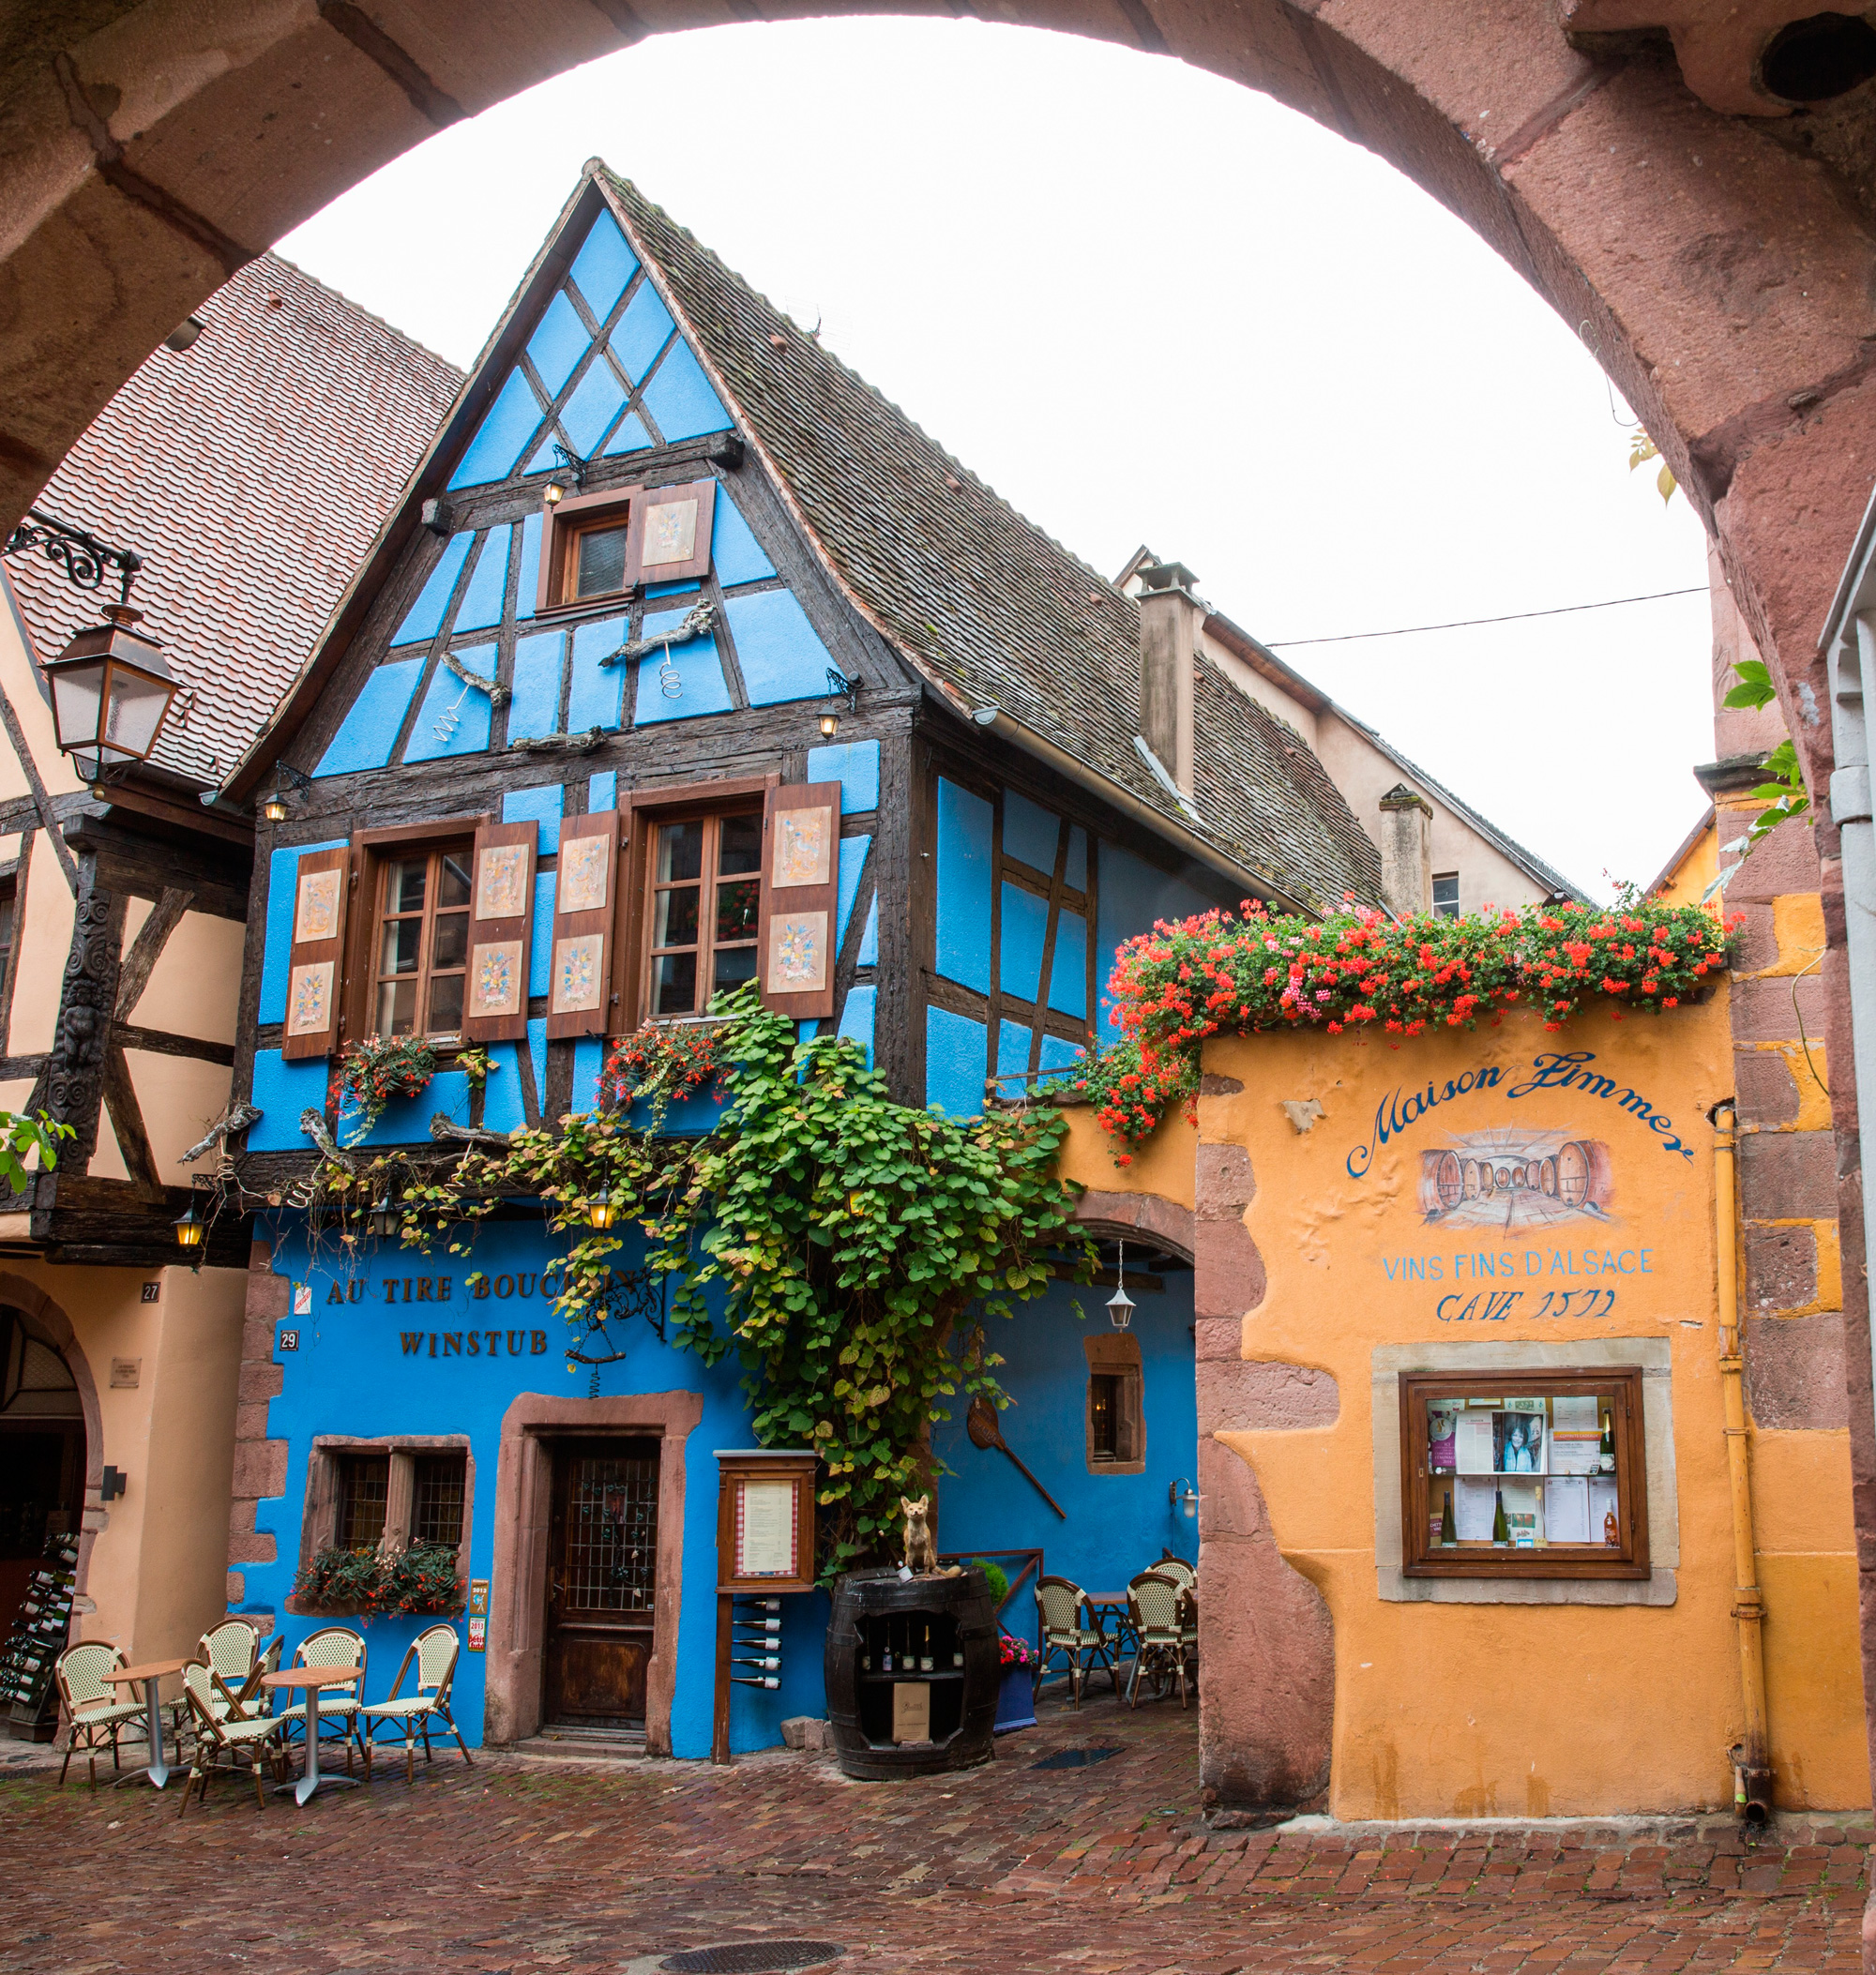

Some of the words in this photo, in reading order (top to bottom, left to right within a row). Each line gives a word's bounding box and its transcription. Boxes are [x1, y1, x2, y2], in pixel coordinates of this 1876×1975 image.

[1347, 1065, 1512, 1179] Maison
[1506, 1051, 1694, 1168] Zimmer
[1383, 1257, 1444, 1281] VINS
[1455, 1252, 1515, 1279] FINS
[1526, 1247, 1655, 1277] D'ALSACE
[144, 1285, 159, 1300] 27
[325, 1278, 365, 1304] AU
[383, 1275, 452, 1303] TIRE
[1436, 1290, 1524, 1324] CAVE
[281, 1333, 296, 1348] 29
[400, 1329, 548, 1357] WINSTUB
